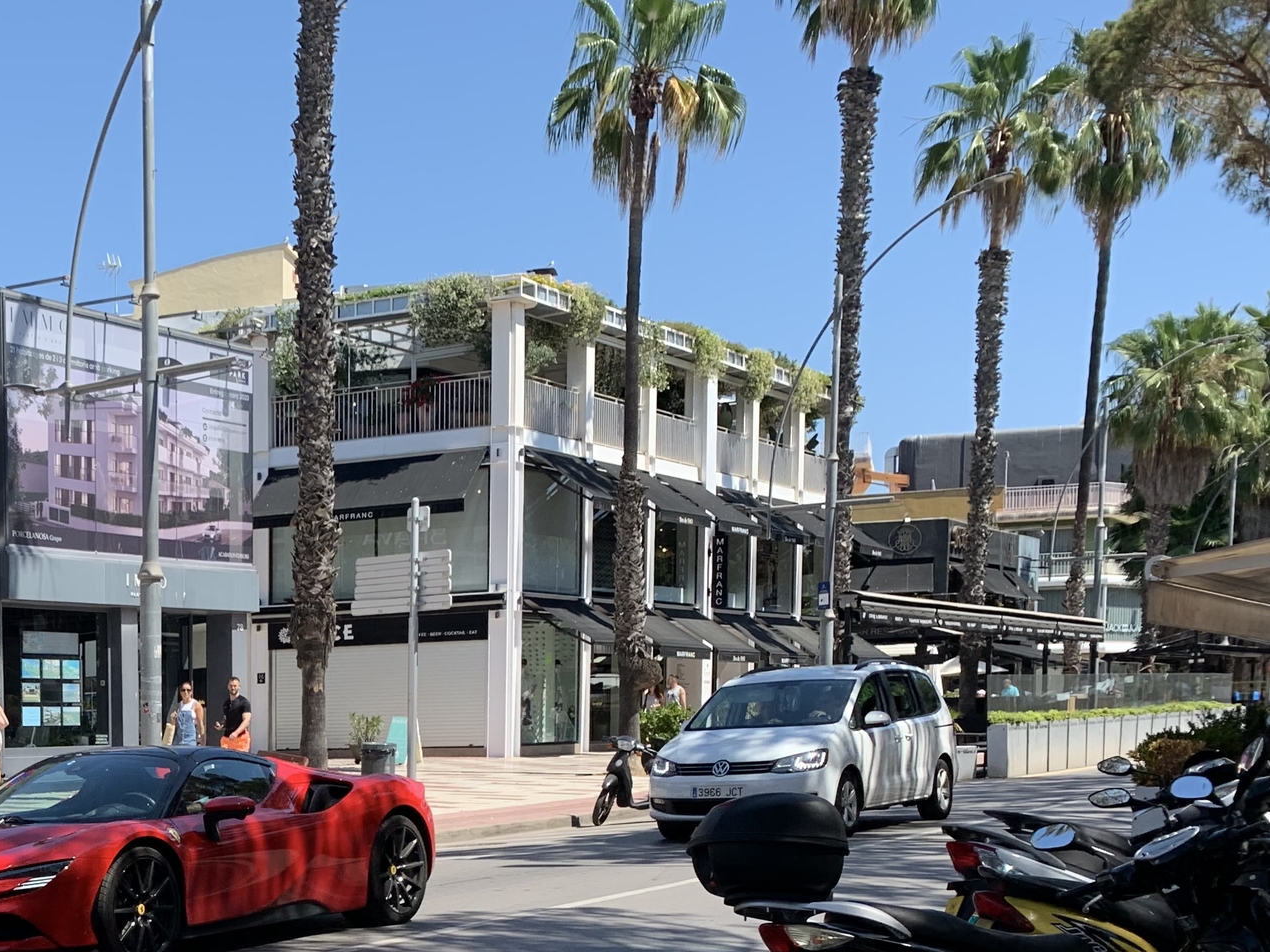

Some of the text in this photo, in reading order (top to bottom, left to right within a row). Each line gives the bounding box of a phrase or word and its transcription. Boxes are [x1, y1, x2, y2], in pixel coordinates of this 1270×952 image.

[334, 512, 374, 520] ARFRANC
[715, 537, 725, 606] MARFRANC
[698, 786, 743, 796] 3966 JCT
